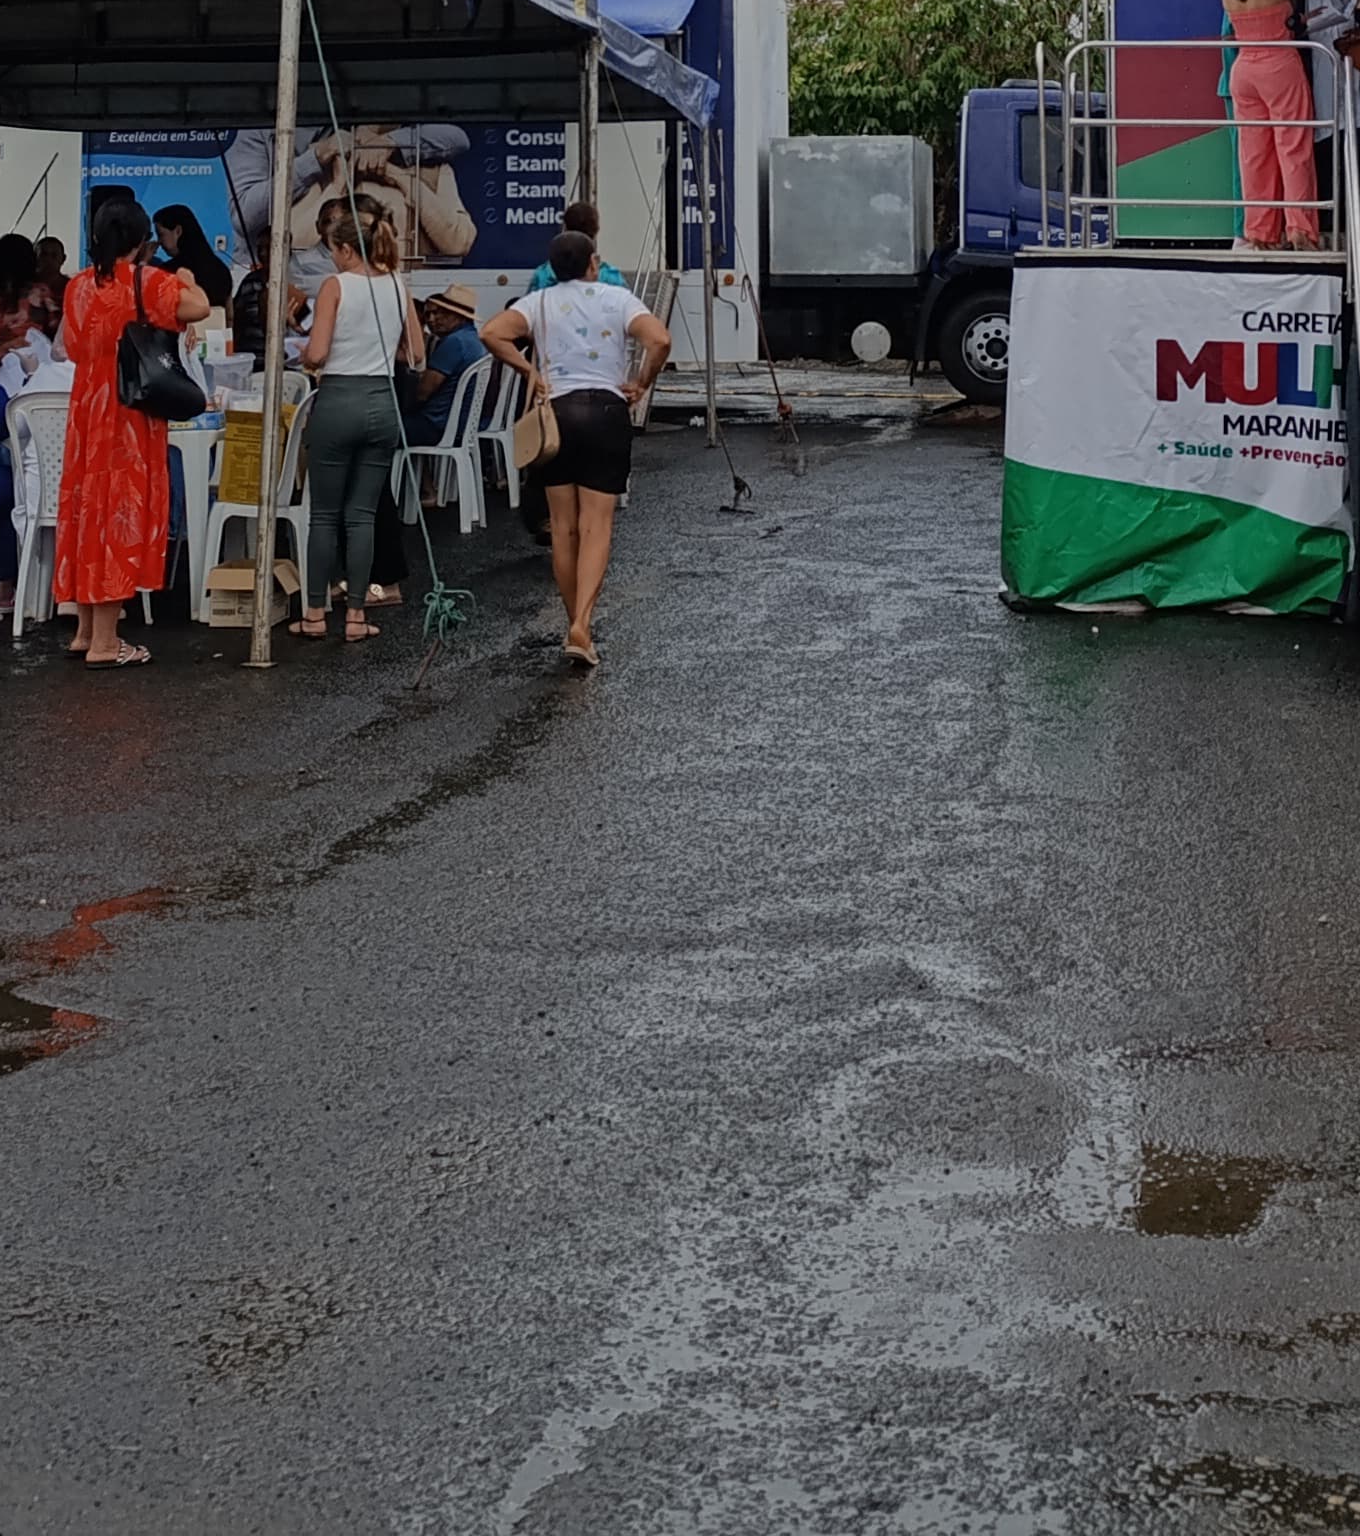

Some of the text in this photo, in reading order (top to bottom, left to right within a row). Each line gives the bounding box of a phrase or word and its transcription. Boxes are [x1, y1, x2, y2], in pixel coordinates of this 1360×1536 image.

[109, 130, 228, 143] Excelência em Saúe!
[506, 129, 565, 146] Consu
[81, 163, 213, 179] pobiocentro.com
[506, 155, 566, 172] Exame
[506, 181, 566, 198] Exame
[506, 207, 564, 225] Medic
[1242, 311, 1343, 336] CARRETA
[1156, 339, 1343, 409] MULH
[1223, 414, 1348, 443] MARANHE
[1174, 441, 1233, 458] Saúde
[1240, 446, 1346, 468] +Prevenção
